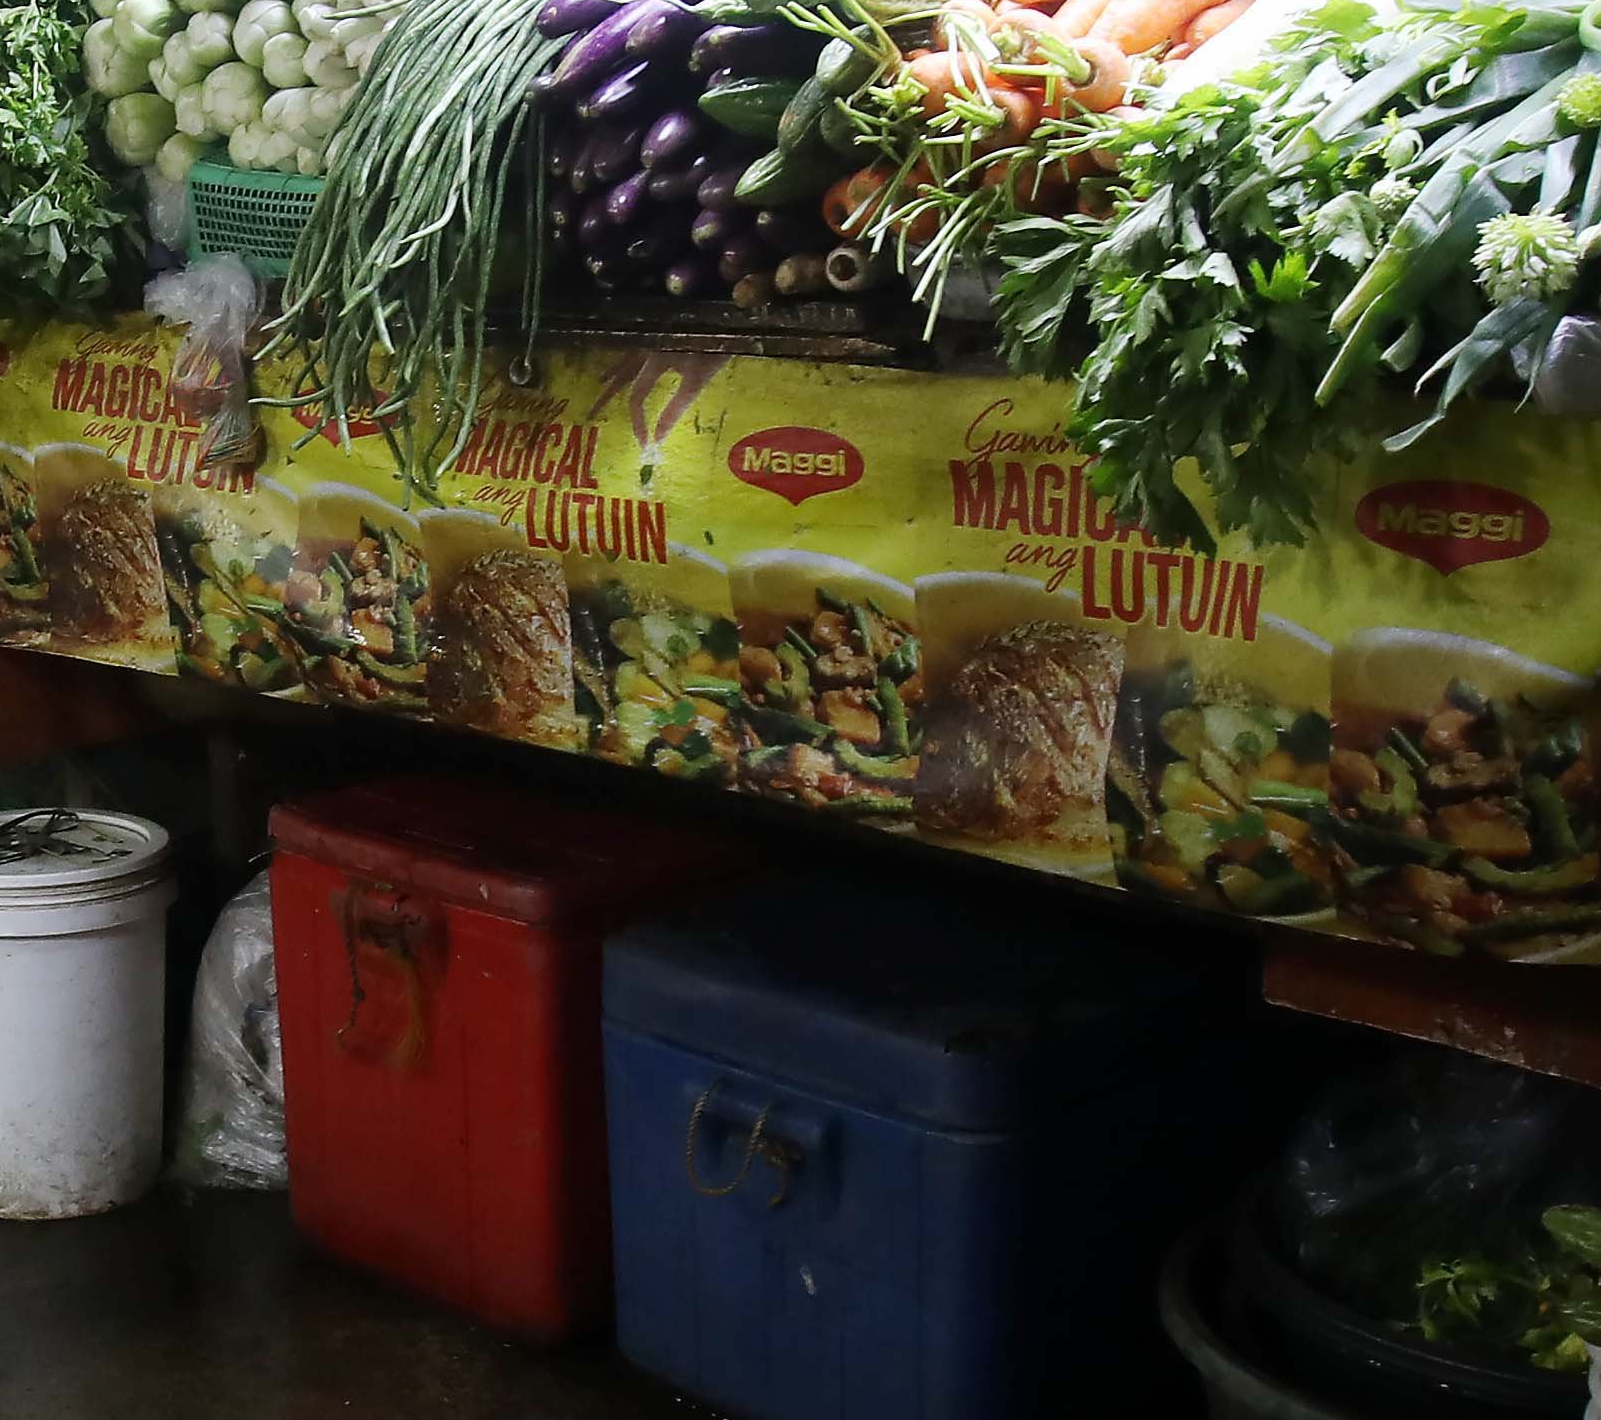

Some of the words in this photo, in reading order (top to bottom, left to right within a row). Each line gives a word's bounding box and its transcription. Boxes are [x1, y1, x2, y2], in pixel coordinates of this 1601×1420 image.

[83, 419, 132, 459] ang
[454, 417, 599, 488] MAGICAL
[742, 445, 847, 477] Maggi
[965, 398, 1099, 467] Gawin
[473, 484, 526, 526] ang
[525, 486, 669, 565] LUTUIN
[949, 459, 1185, 548] MAGIC
[1376, 502, 1525, 544] Maggi
[1005, 542, 1079, 593] ang
[1082, 545, 1264, 642] LUTUIN
